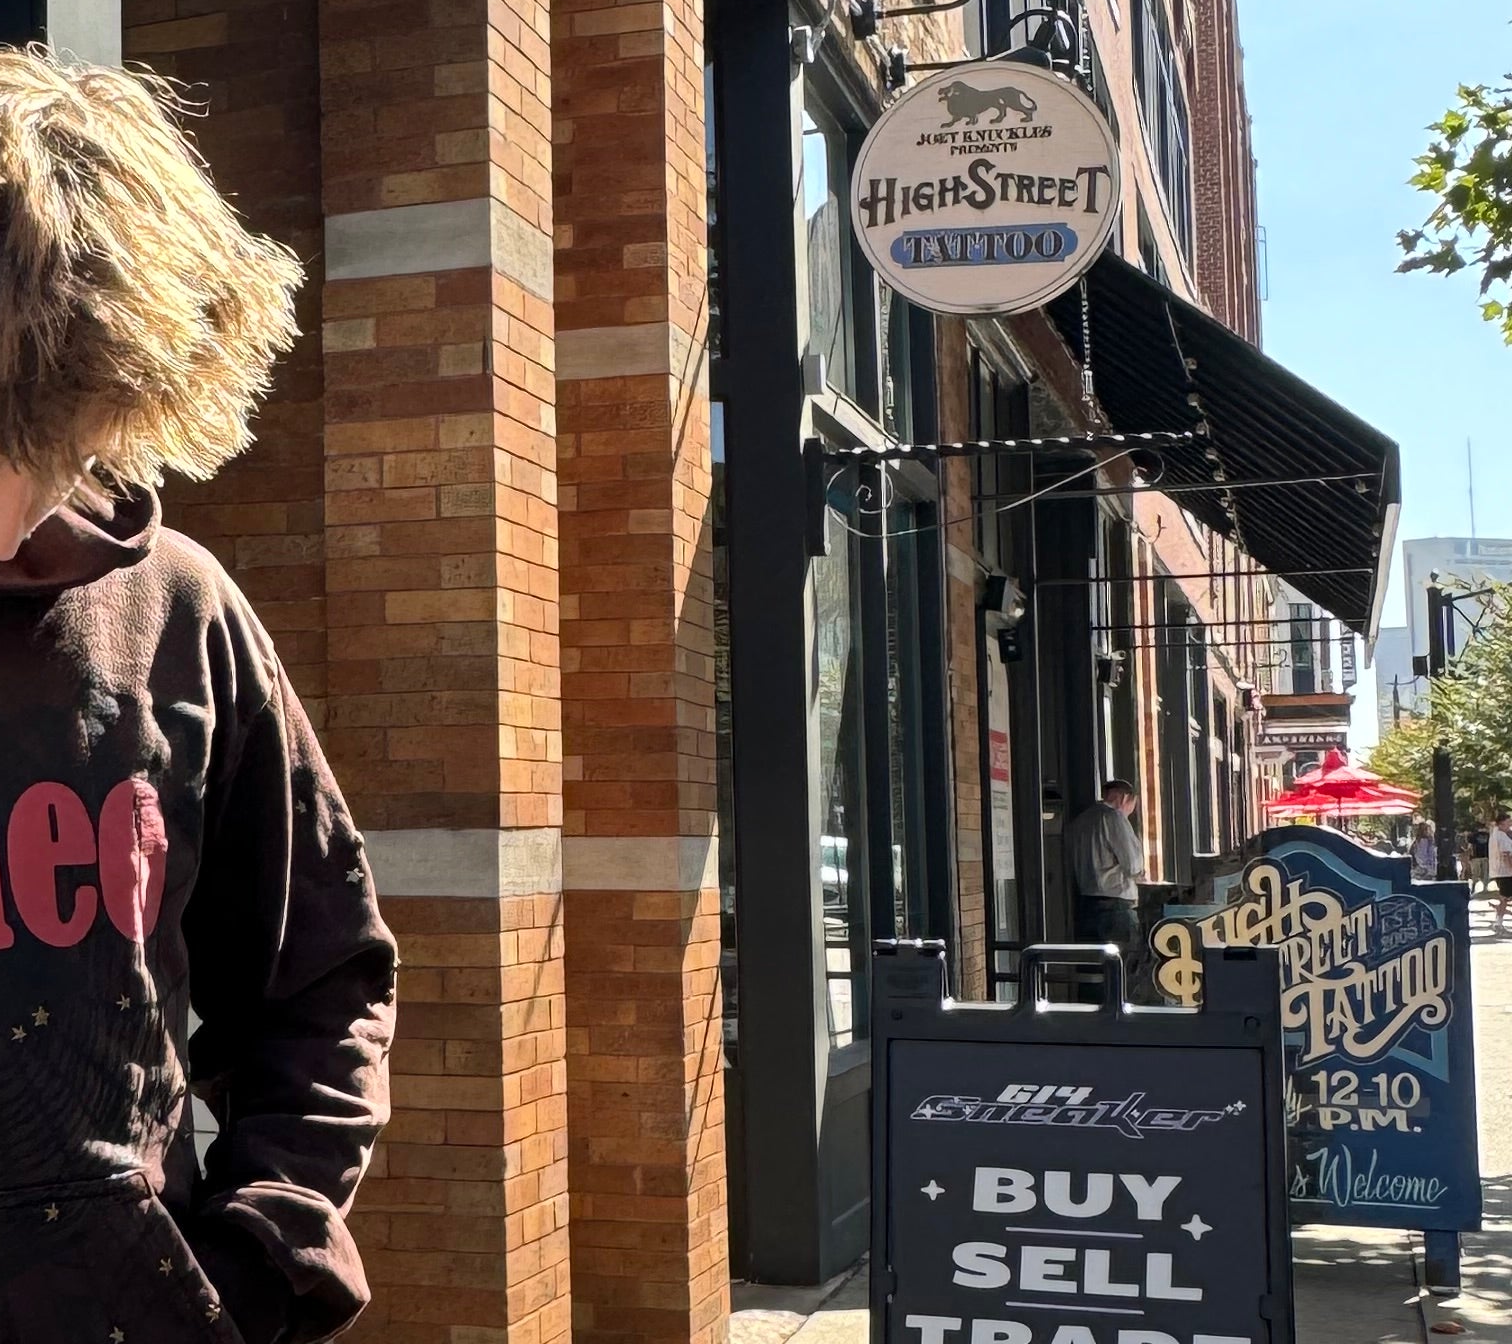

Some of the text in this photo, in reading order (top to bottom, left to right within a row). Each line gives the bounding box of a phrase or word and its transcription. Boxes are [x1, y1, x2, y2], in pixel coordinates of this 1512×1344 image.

[902, 229, 1065, 265] TATTOO
[1283, 937, 1449, 1063] TATTOO
[996, 1084, 1094, 1105] 614
[1316, 1107, 1422, 1133] P.M.
[973, 1166, 1182, 1222] BUY
[1306, 1144, 1448, 1208] Welcome
[951, 1241, 1204, 1302] SELL
